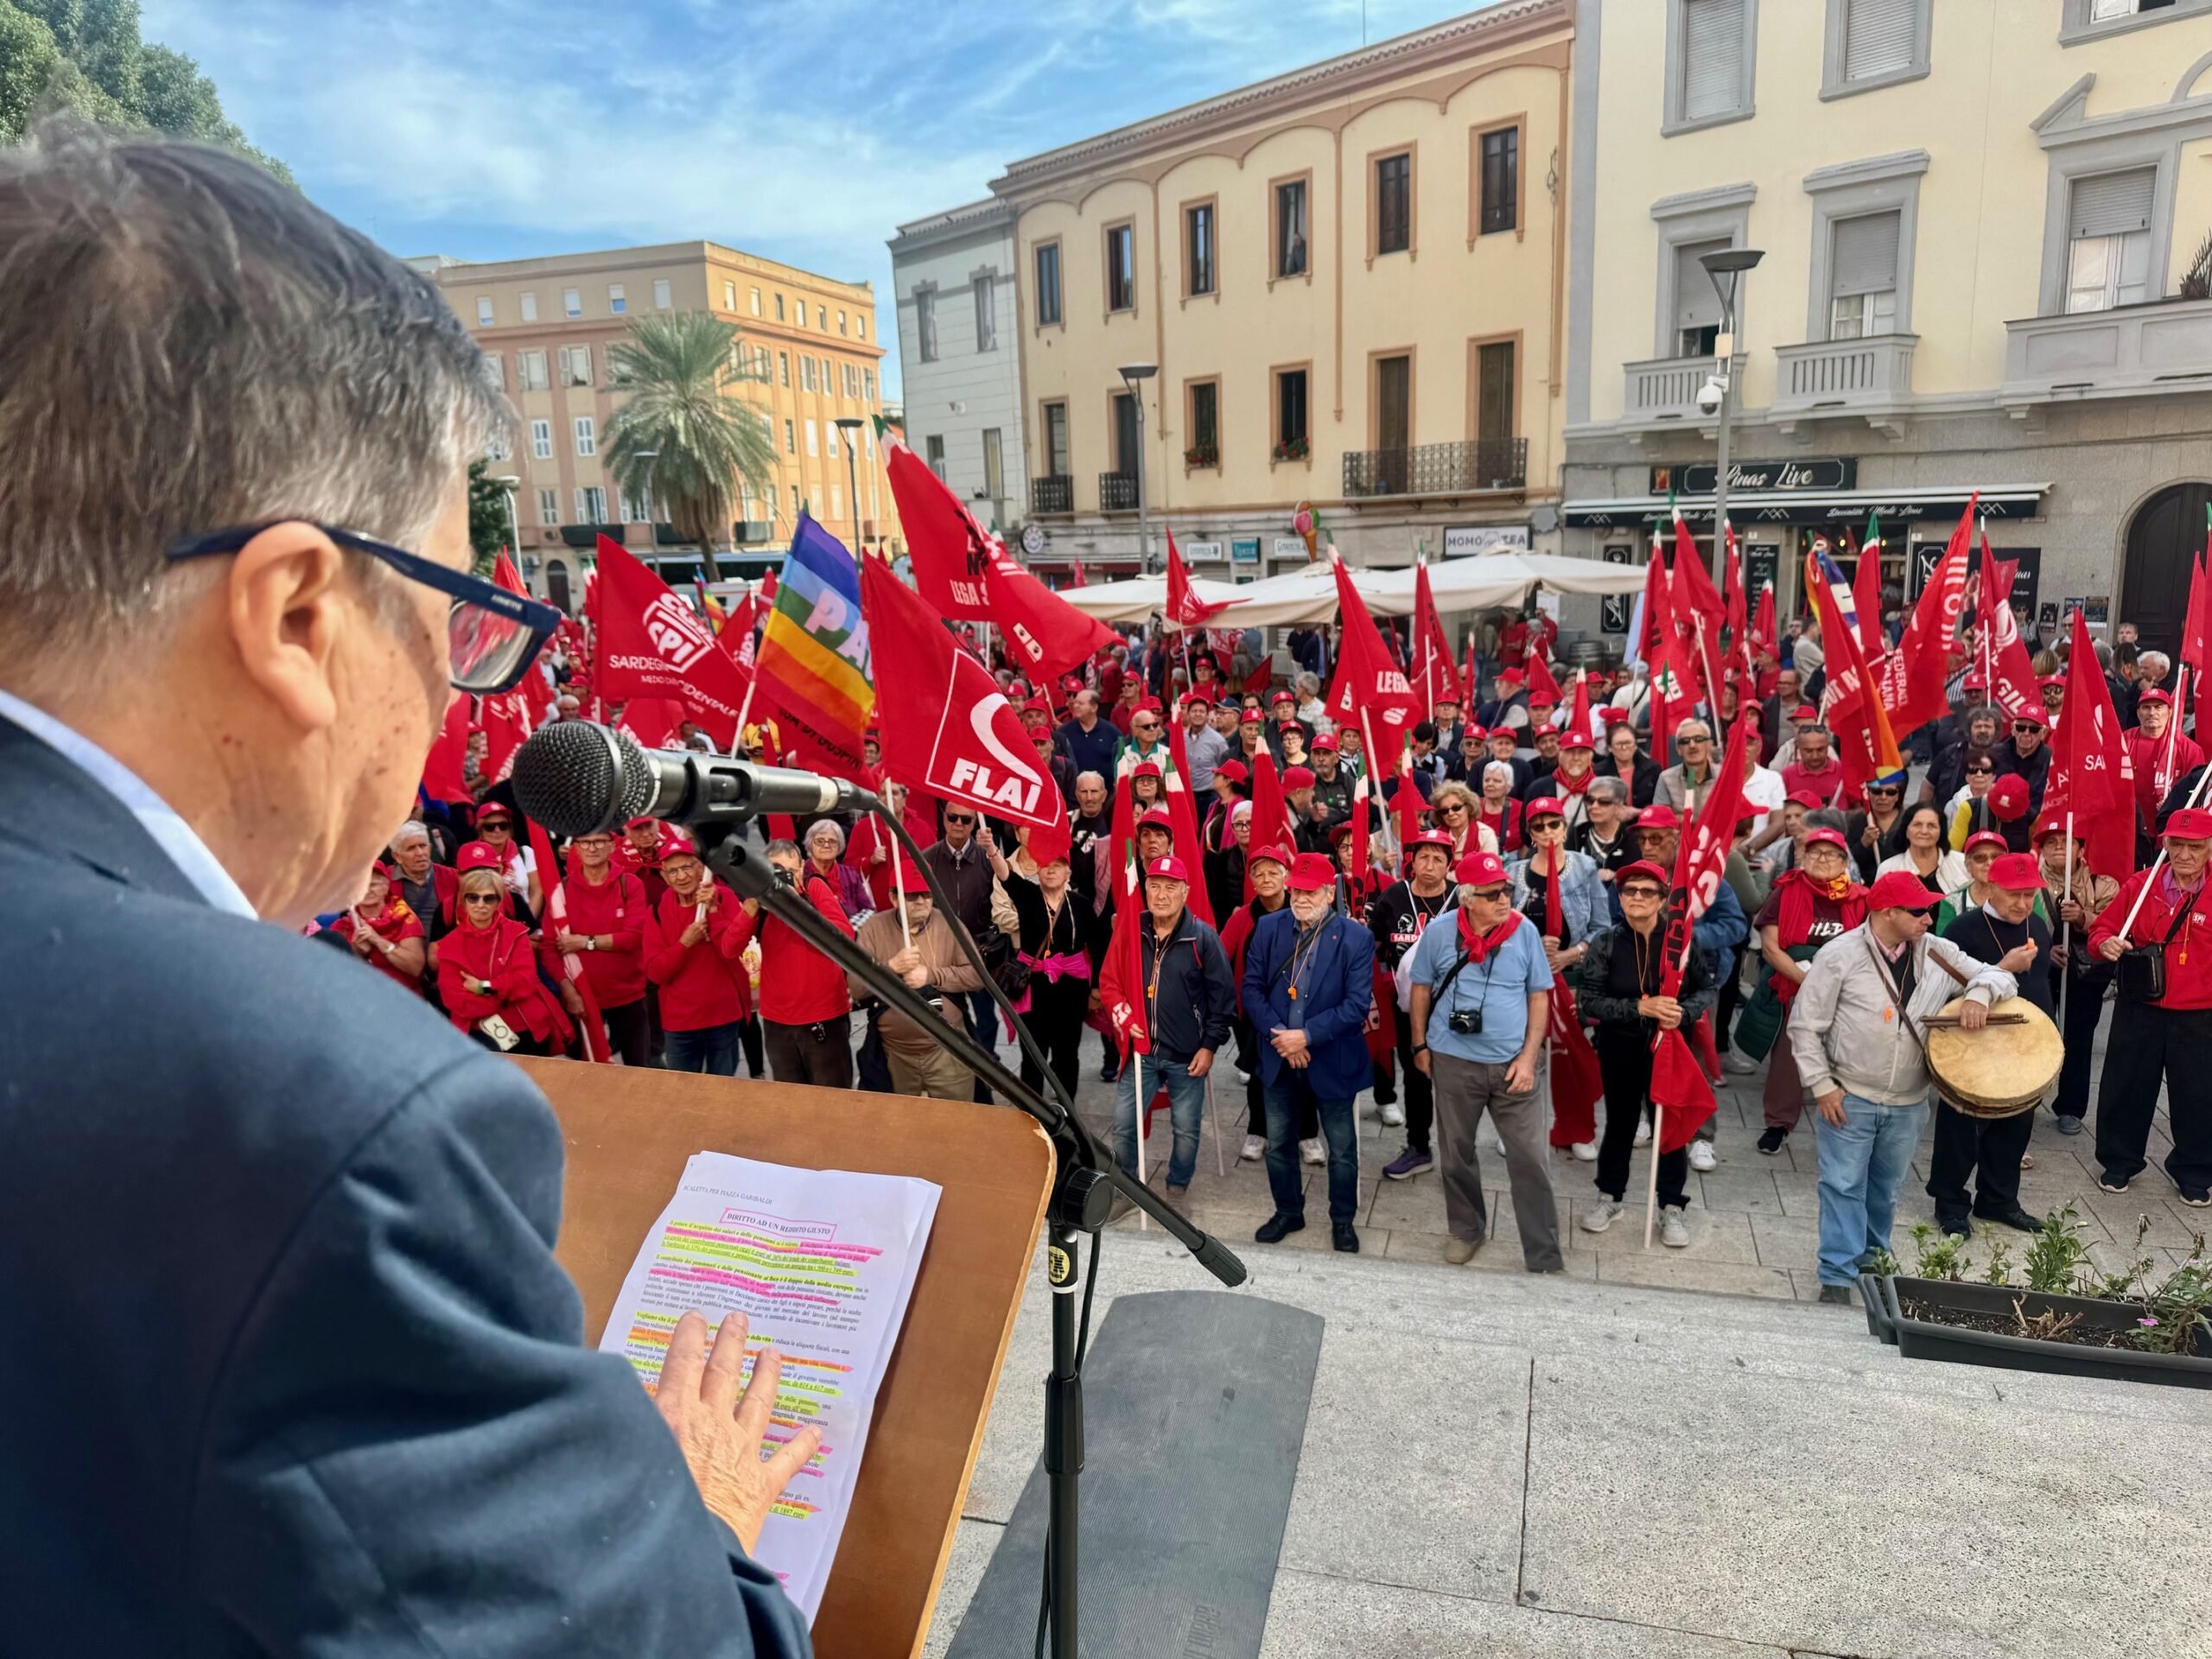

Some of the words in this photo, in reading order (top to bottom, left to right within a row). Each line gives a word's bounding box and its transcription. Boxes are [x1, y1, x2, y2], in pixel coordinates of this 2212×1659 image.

[1775, 462, 1814, 488] Live
[1447, 536, 1483, 547] MOMO
[1500, 534, 1525, 545] TEA
[648, 621, 695, 664] SPI
[804, 588, 872, 681] PA
[950, 757, 1042, 814] FLAI
[741, 1192, 772, 1205] GARIBALDI
[727, 1212, 756, 1224] DIRITTO
[768, 1221, 779, 1230] UN
[779, 1224, 807, 1233] REDDITO
[753, 1235, 776, 1244] pensioni
[734, 1268, 762, 1280] pensionate
